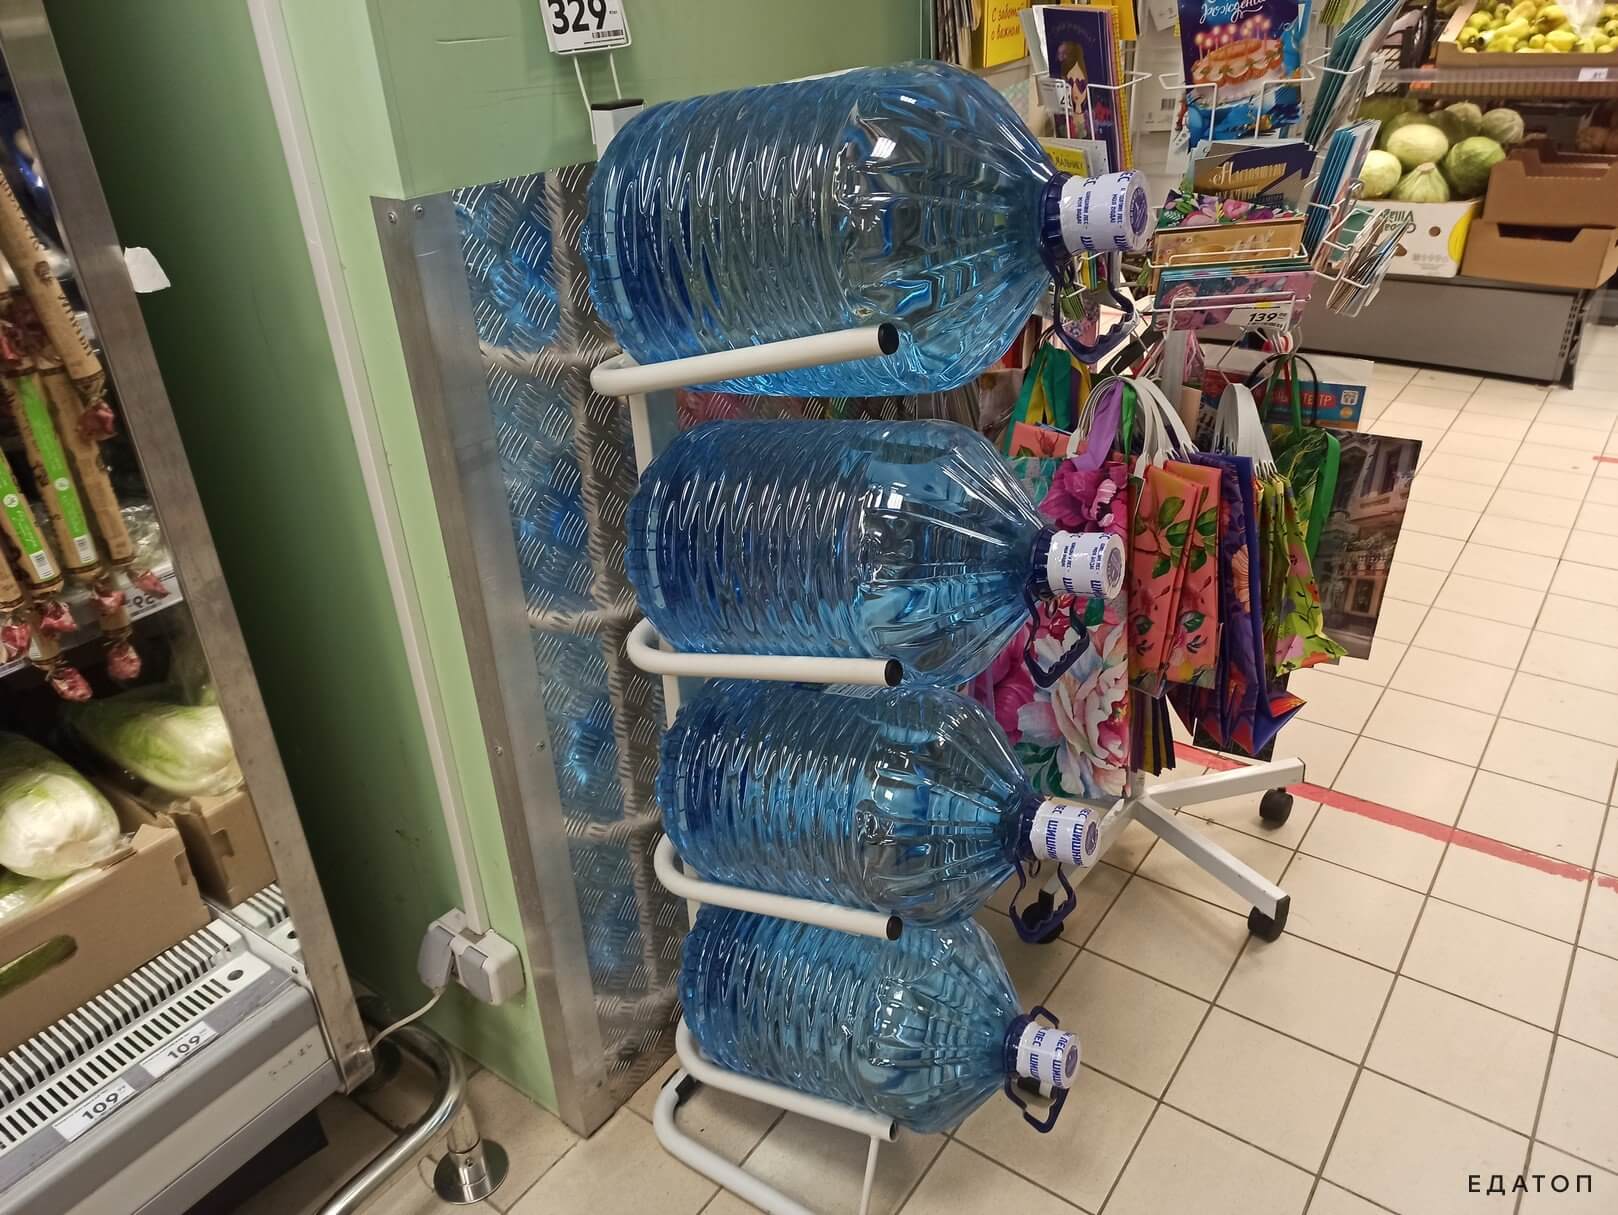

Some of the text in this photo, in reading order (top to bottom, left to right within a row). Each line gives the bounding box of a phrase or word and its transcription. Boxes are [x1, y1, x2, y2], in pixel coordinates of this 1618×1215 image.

[548, 0, 607, 35] 329
[1249, 312, 1278, 322] 139
[1303, 393, 1331, 406] ТЕТР
[167, 1035, 201, 1059] 109
[82, 1092, 119, 1120] 109
